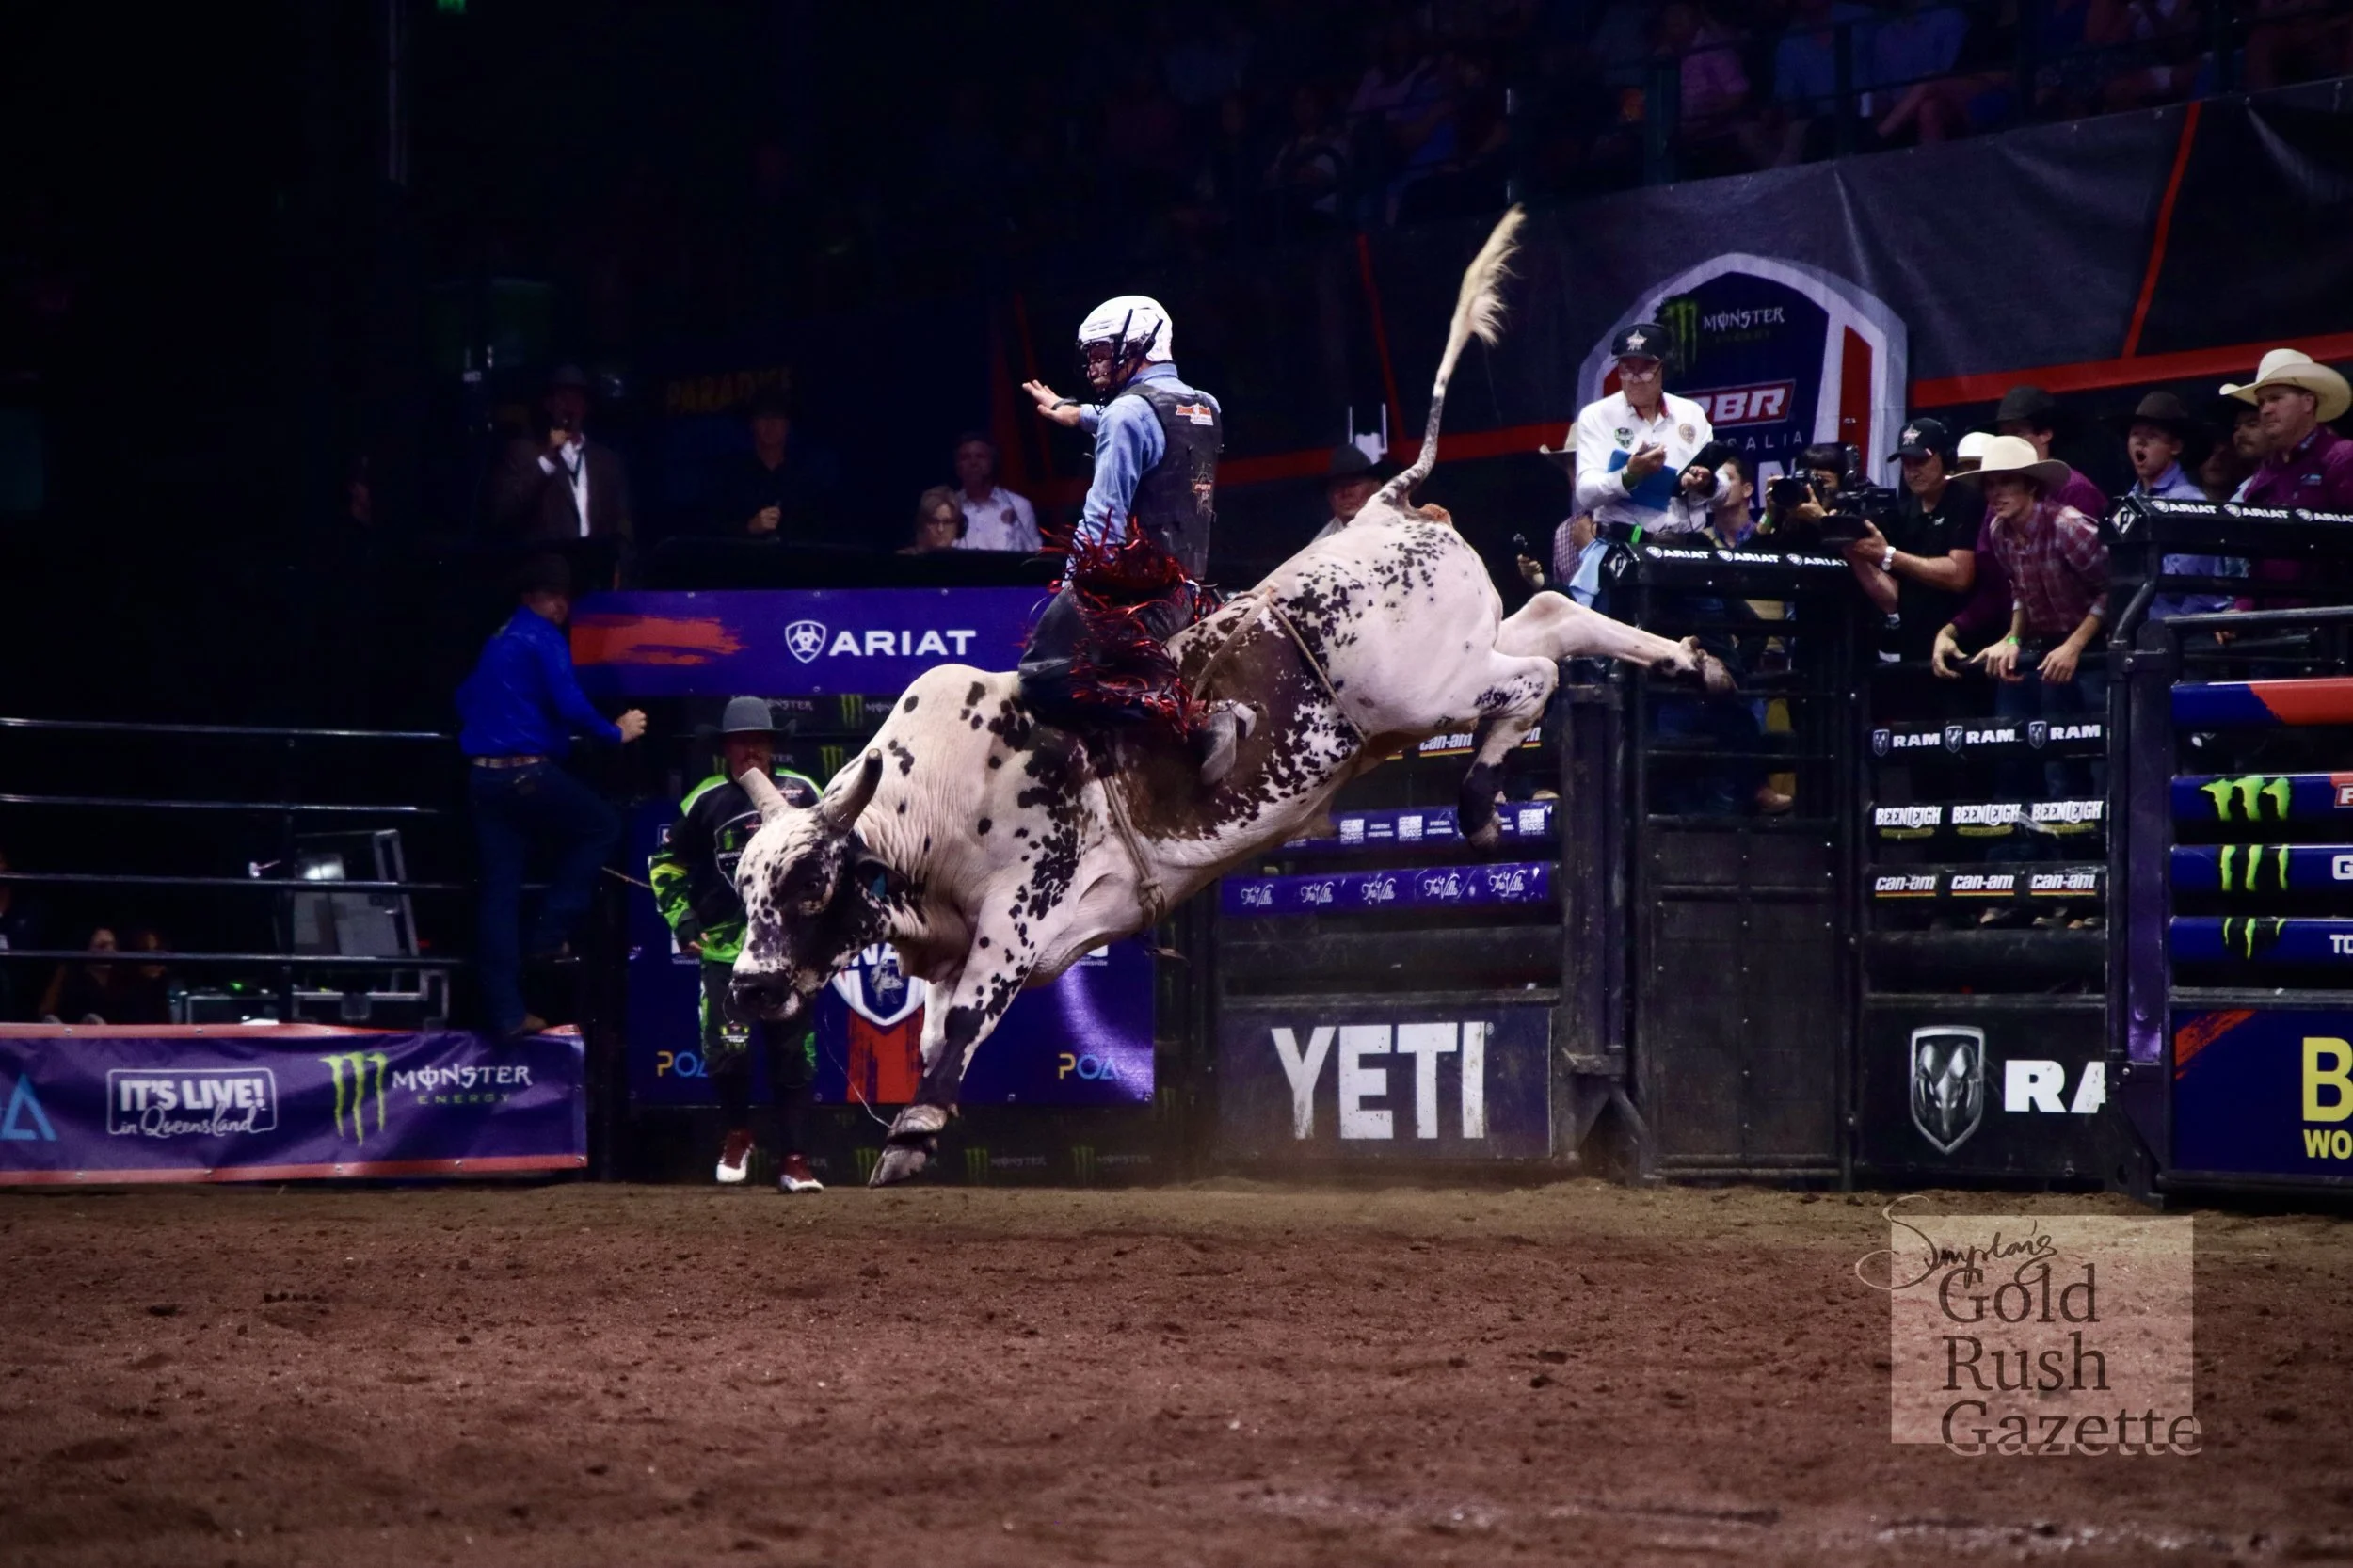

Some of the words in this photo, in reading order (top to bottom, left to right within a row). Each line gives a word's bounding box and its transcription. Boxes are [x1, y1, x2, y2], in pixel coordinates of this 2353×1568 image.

[1703, 306, 1785, 332] MONSTER
[2169, 503, 2217, 515] ARIAT
[2242, 507, 2289, 520] ARIAT
[1664, 549, 1711, 560] ARIAT
[1734, 552, 1781, 564] ARIAT
[828, 630, 977, 657] ARIAT
[1893, 733, 1942, 748] RAM
[1966, 729, 2015, 744] RAM
[2050, 725, 2102, 741] RAM
[1875, 875, 1938, 890] can-am
[1951, 874, 2015, 890] can-am
[2030, 874, 2096, 890] can-am
[392, 1064, 533, 1091] MONSTER
[1271, 1021, 1485, 1140] YETI
[2005, 1060, 2105, 1113] RA
[119, 1080, 177, 1112] IT'S
[182, 1078, 264, 1110] LIVE!
[417, 1093, 510, 1105] ENERGY
[140, 1100, 259, 1139] Queensland
